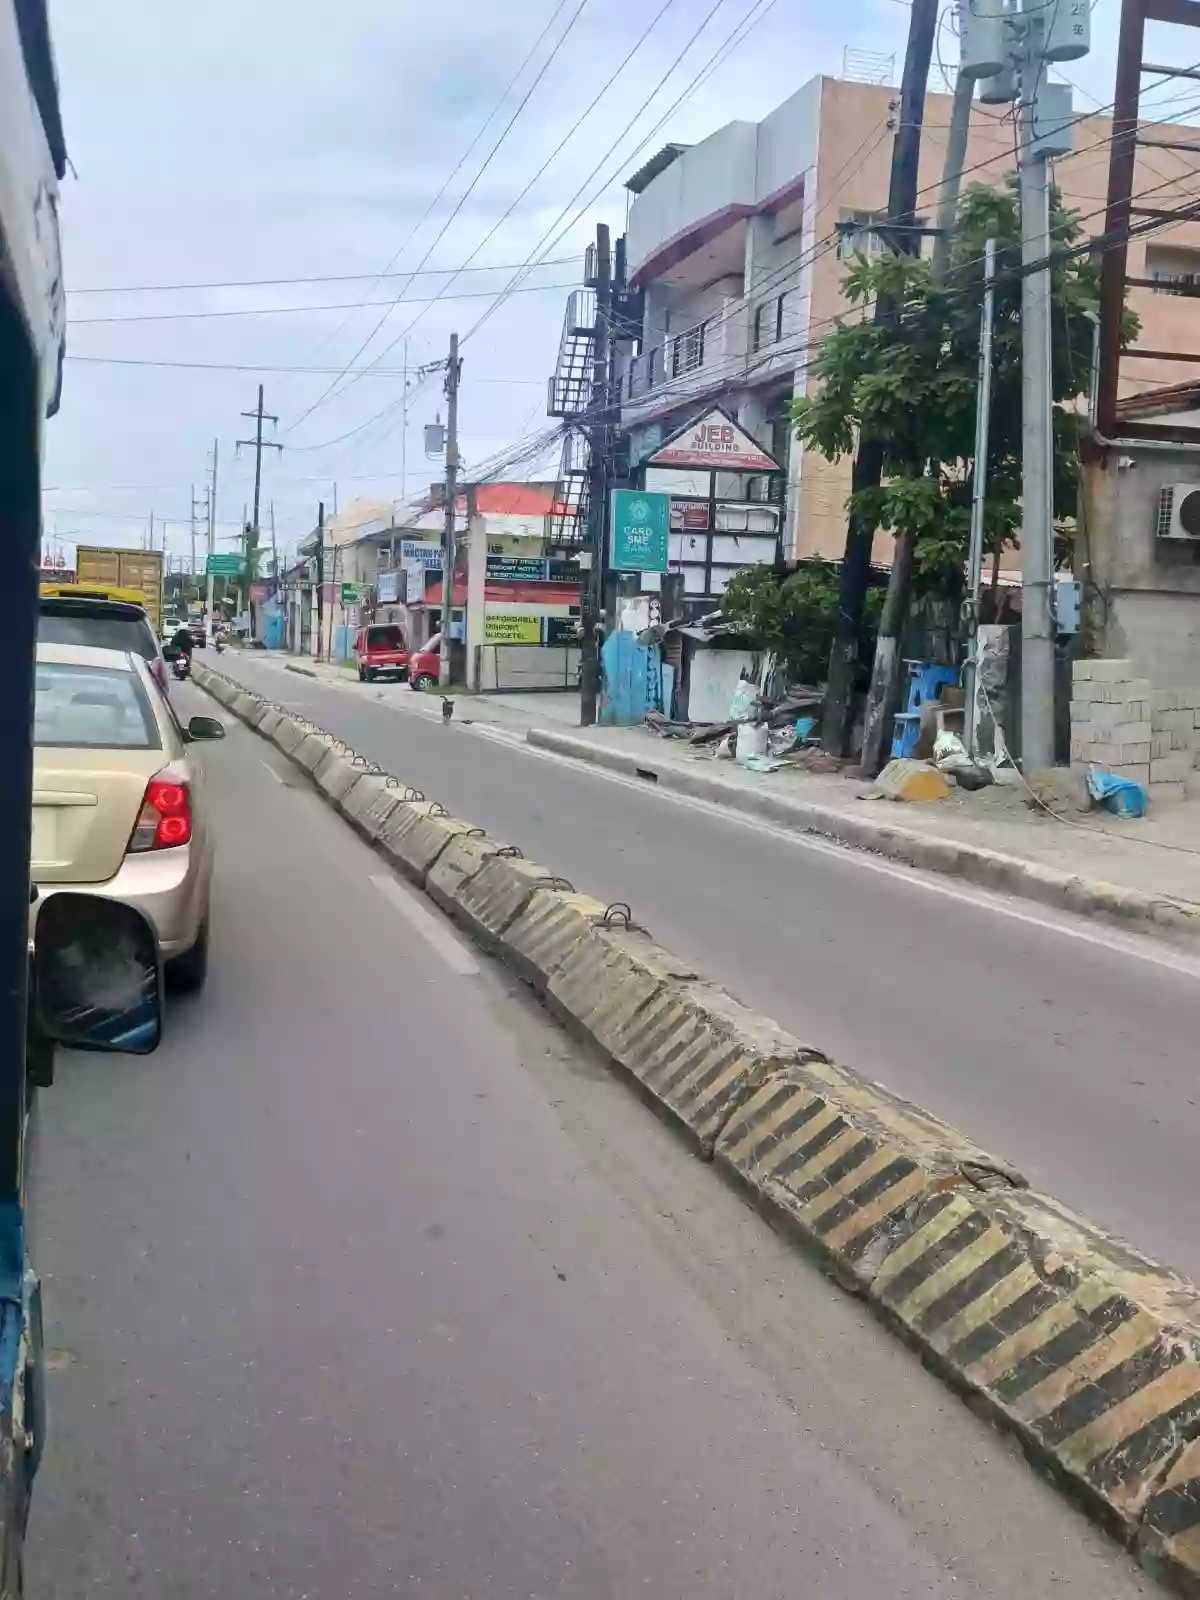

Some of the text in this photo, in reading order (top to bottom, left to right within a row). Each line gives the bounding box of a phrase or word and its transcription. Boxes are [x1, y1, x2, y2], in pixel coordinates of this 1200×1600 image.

[695, 424, 735, 443] JEB
[690, 441, 739, 452] BUILDING
[623, 525, 653, 537] CARD
[627, 535, 649, 545] SME
[621, 542, 653, 553] BANK
[485, 615, 538, 624] AFFORDABLE
